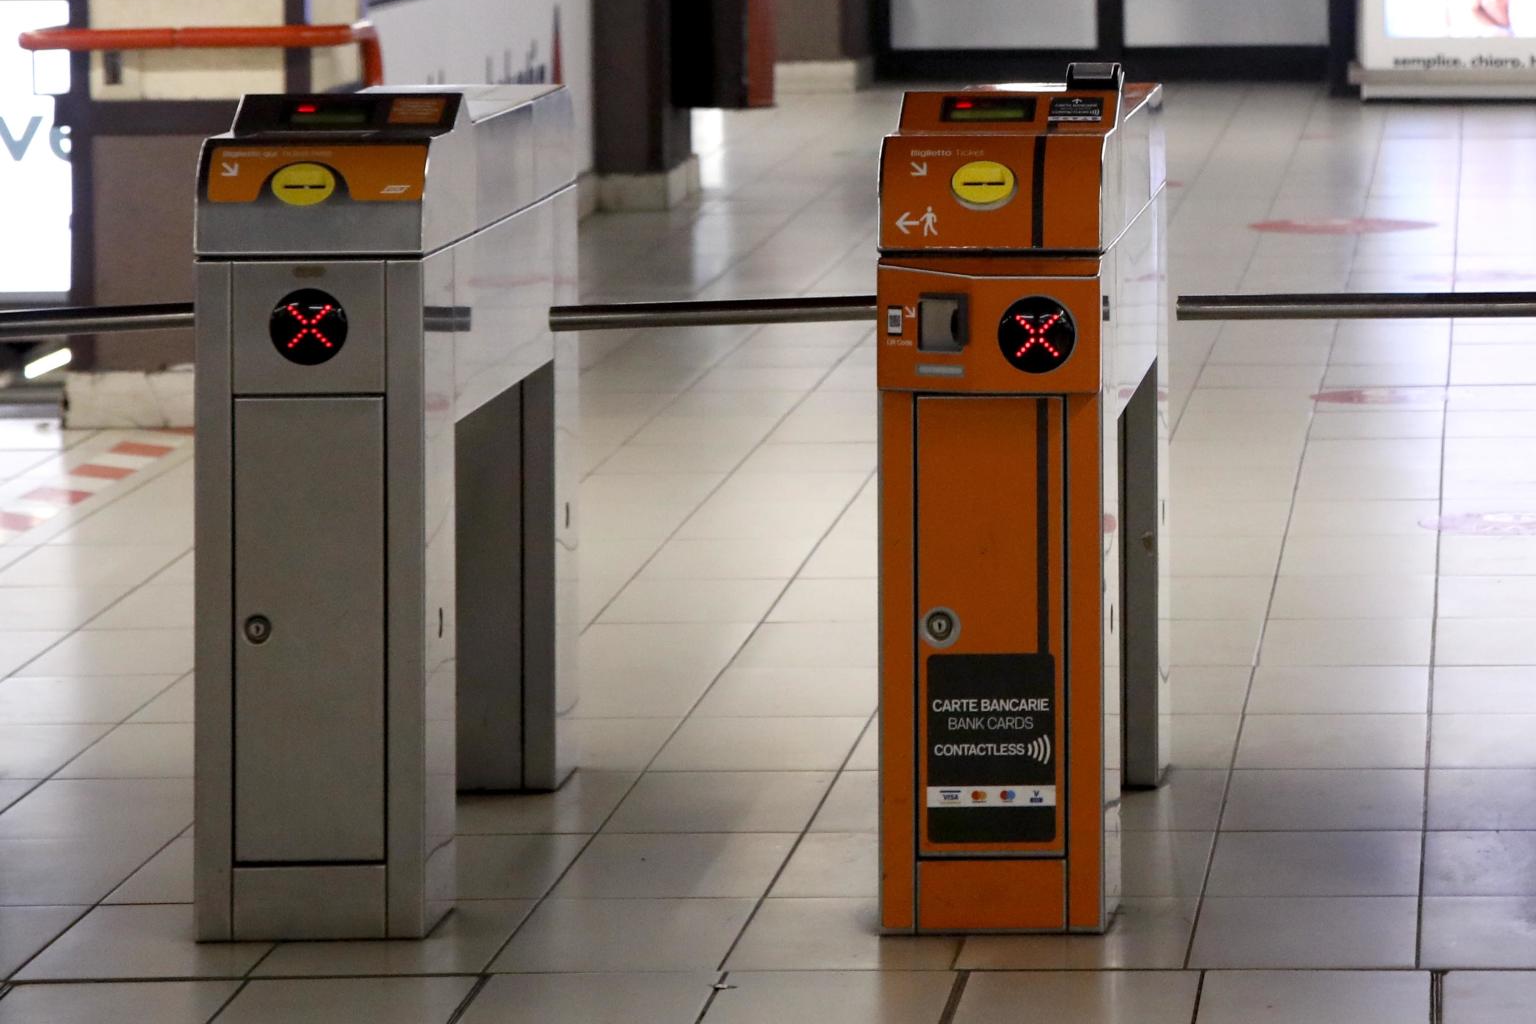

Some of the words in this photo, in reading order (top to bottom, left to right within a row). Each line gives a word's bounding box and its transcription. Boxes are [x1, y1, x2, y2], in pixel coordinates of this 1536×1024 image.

[933, 700, 978, 712] CARTE
[981, 699, 1049, 711] BANCARIE
[948, 718, 984, 730] BANK
[988, 717, 1033, 729] CARDS
[934, 744, 1025, 755] CONTACTLESS
